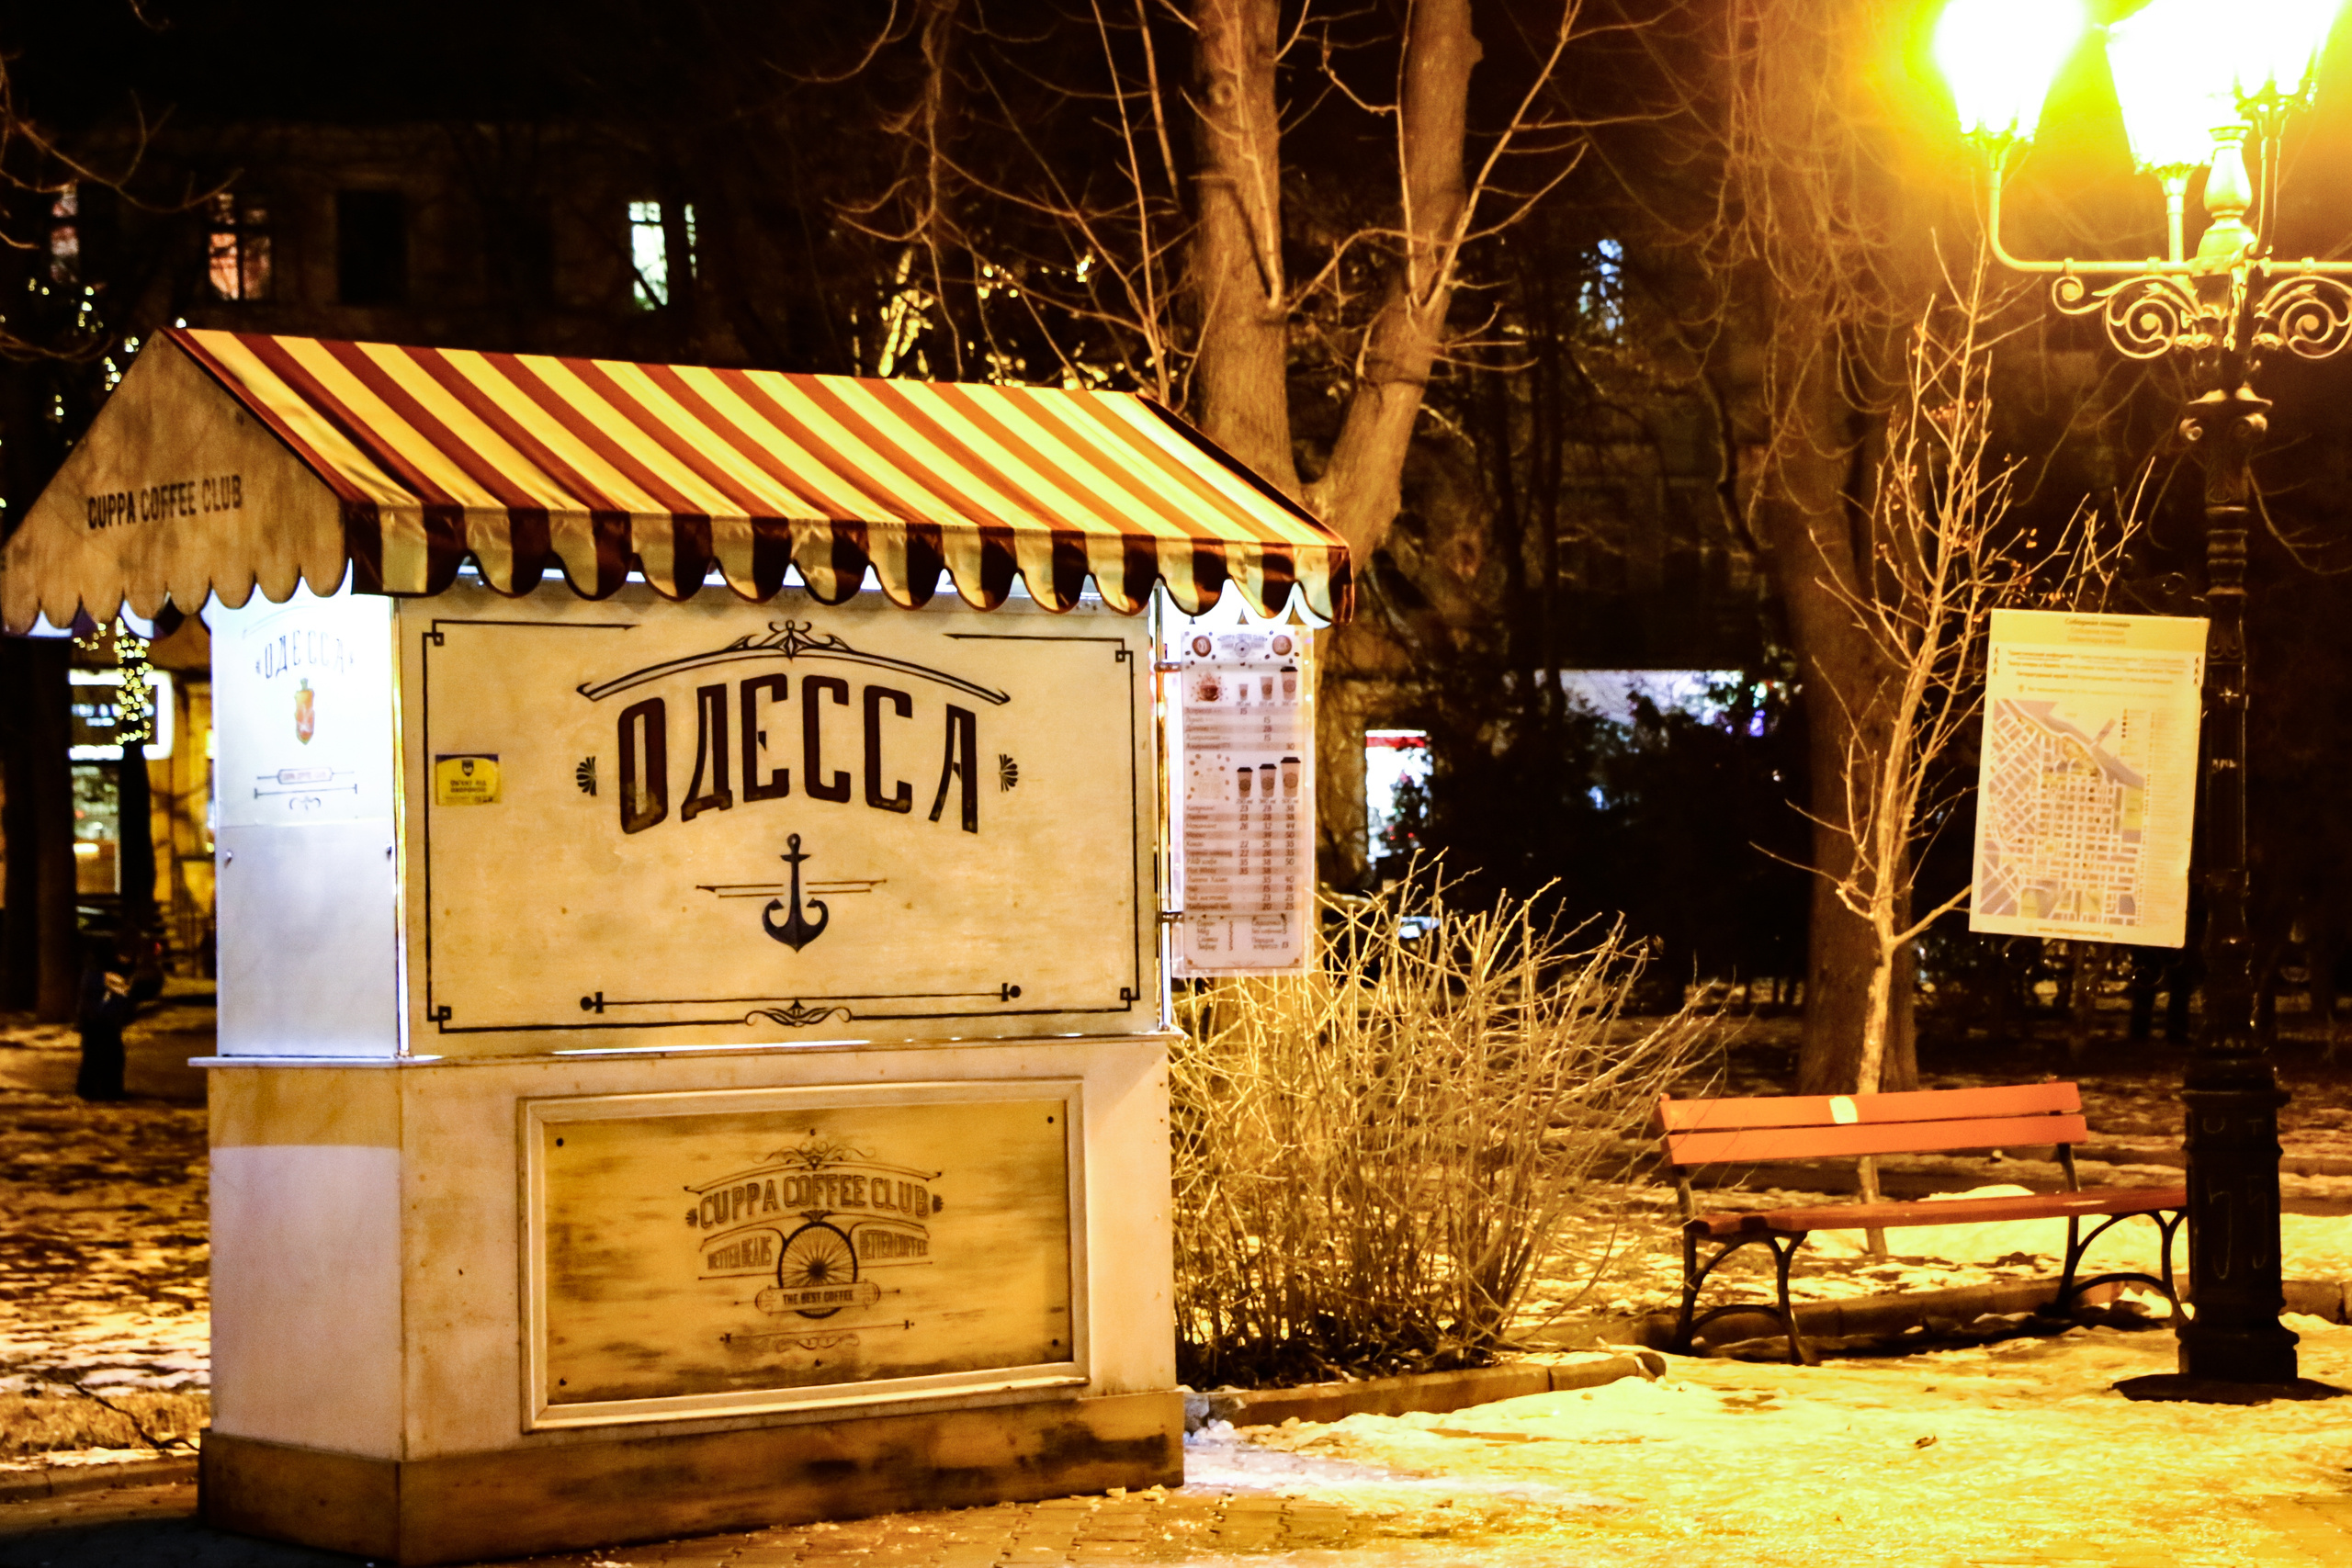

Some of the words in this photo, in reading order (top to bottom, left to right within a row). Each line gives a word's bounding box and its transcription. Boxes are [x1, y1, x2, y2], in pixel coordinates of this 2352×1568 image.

[87, 491, 137, 530] CUPPA
[140, 480, 197, 523] COFFEE
[201, 474, 243, 513] CLUB
[265, 629, 344, 679] ОДЕССА
[617, 673, 978, 834] ОДЕССА
[700, 1179, 779, 1230] CUPPA
[783, 1174, 867, 1209] COFFEE
[871, 1177, 930, 1220] CLUB
[783, 1293, 797, 1305] THE
[800, 1292, 820, 1304] BEST
[823, 1290, 853, 1303] COFFEE
